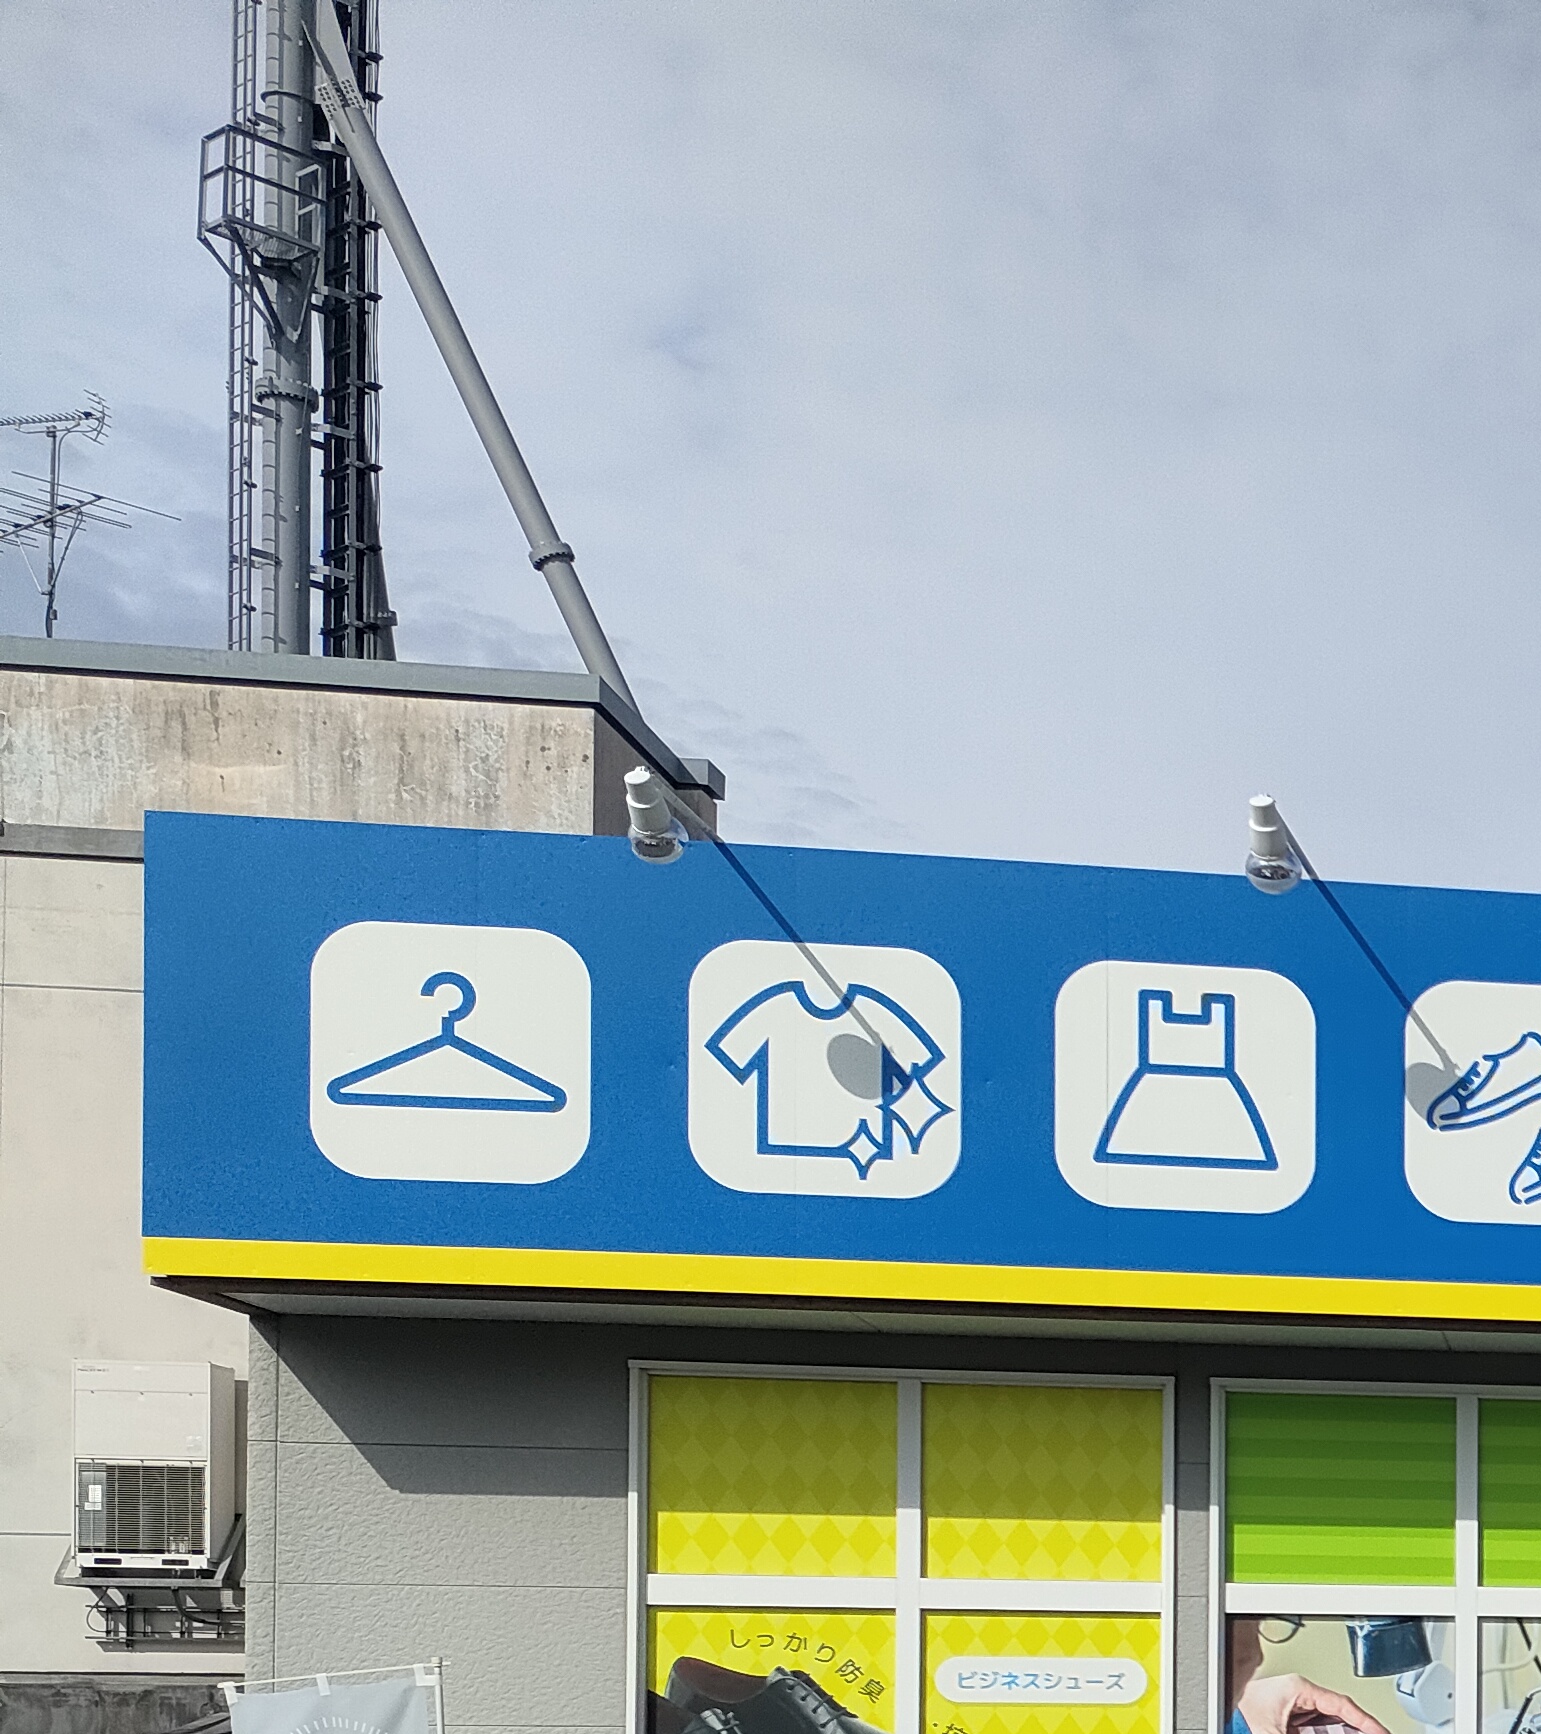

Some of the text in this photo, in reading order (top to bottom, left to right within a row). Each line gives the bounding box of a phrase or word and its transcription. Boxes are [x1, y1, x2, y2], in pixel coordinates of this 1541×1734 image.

[955, 1670, 1125, 1694] ビジネスシューズ
